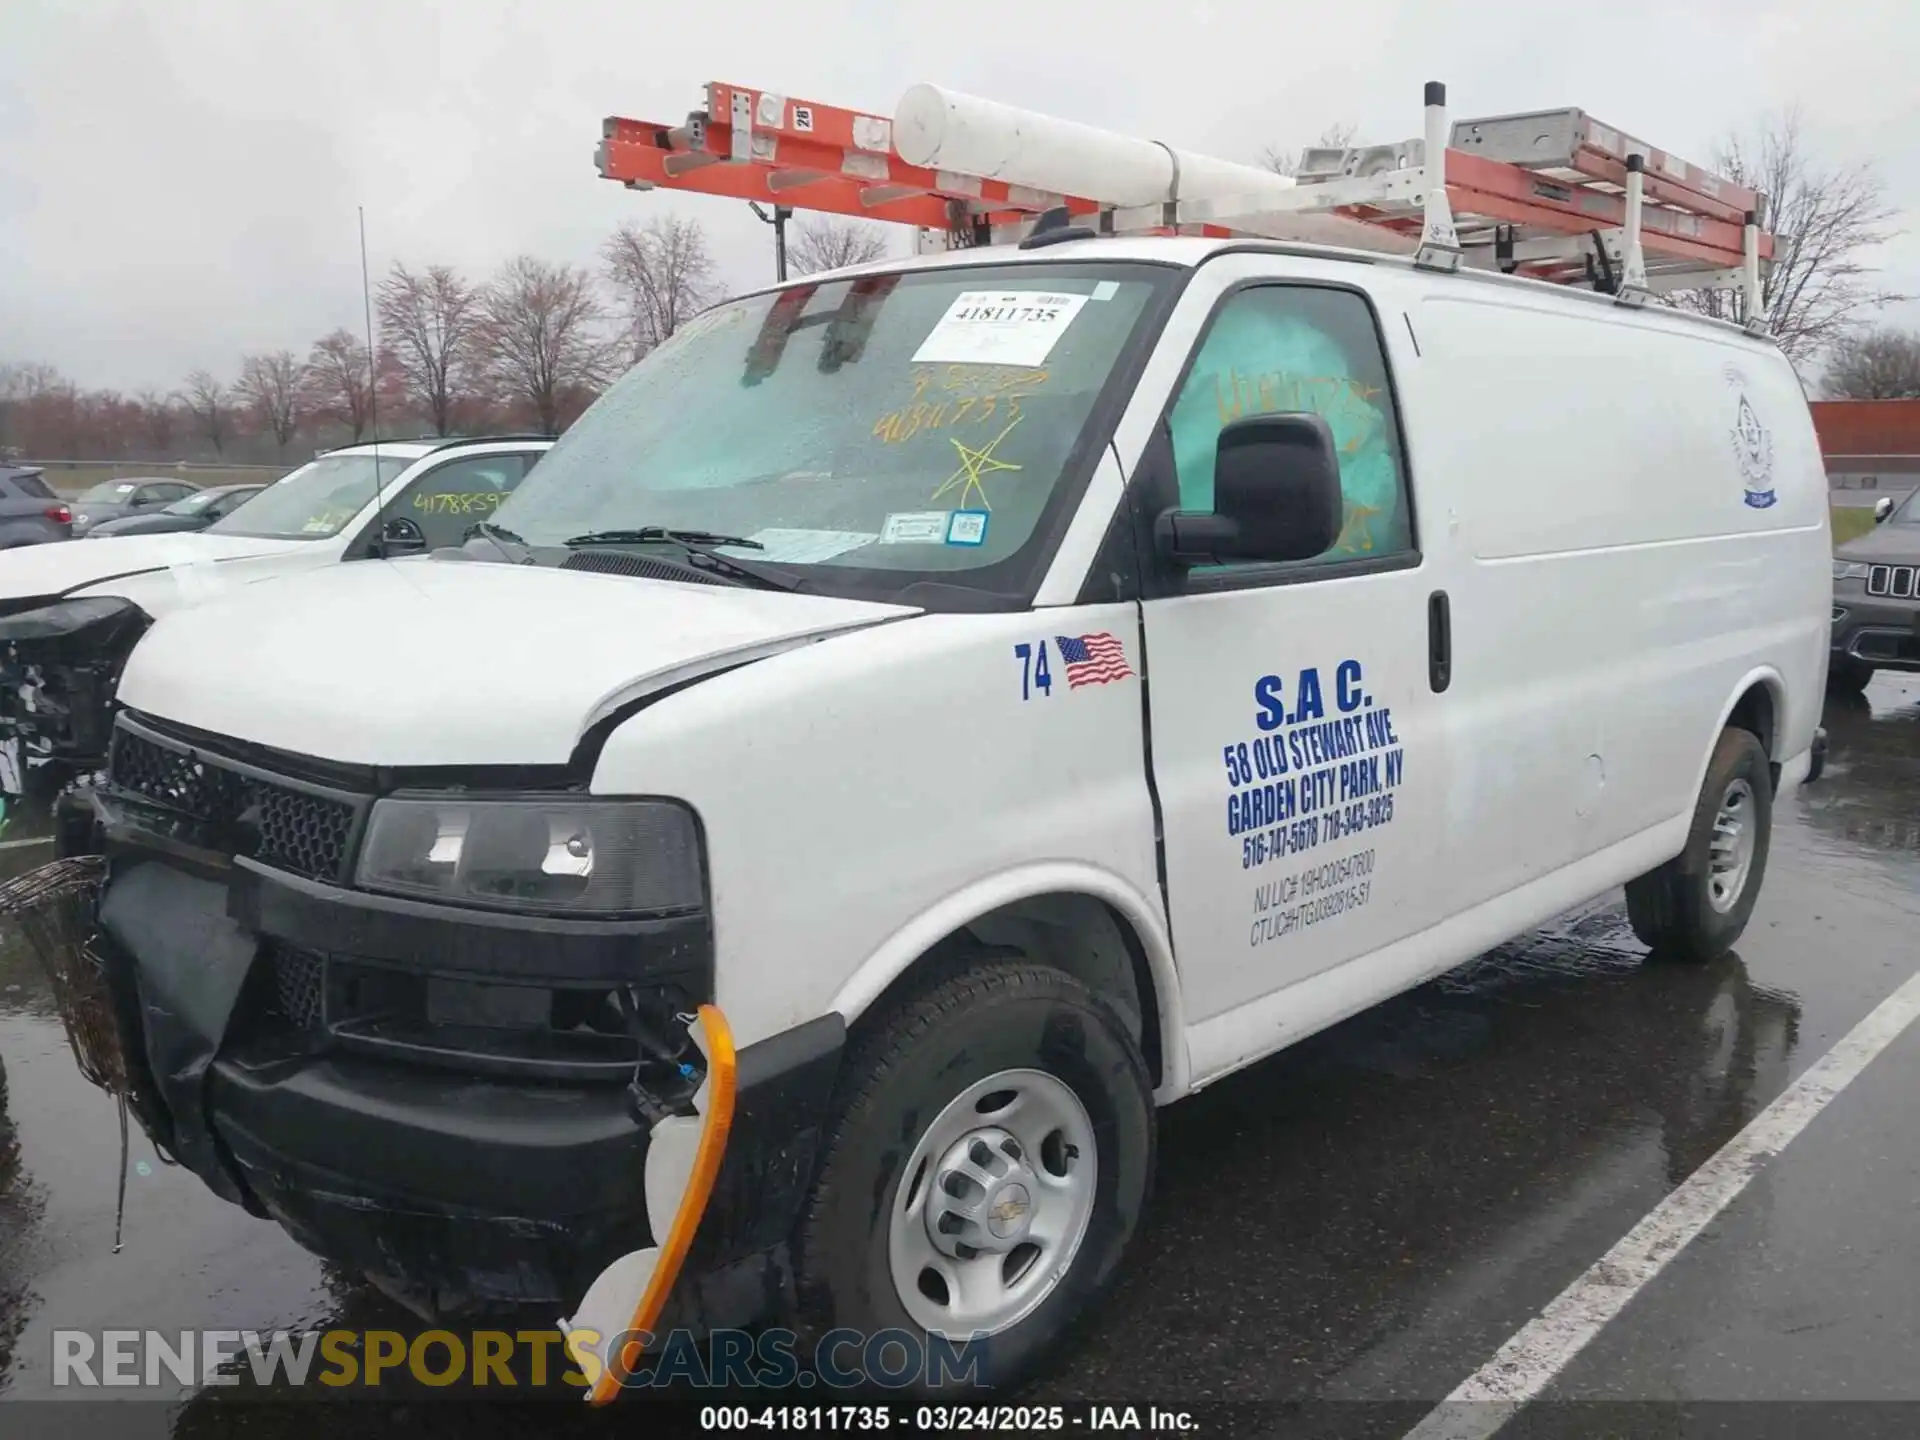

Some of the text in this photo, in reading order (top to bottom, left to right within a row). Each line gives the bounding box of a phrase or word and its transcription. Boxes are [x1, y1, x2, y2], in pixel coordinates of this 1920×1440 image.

[956, 307, 1059, 322] 41811735
[1014, 639, 1051, 700] 74
[1224, 742, 1252, 787] 58
[1254, 734, 1289, 780] OLD
[1289, 715, 1364, 770] STEWART
[1227, 748, 1404, 836] GARDEN CITY PARK, NY
[1242, 793, 1394, 869] 516-747-5678 718-343-3825
[1254, 886, 1270, 914] NJ
[1250, 918, 1268, 947] CT
